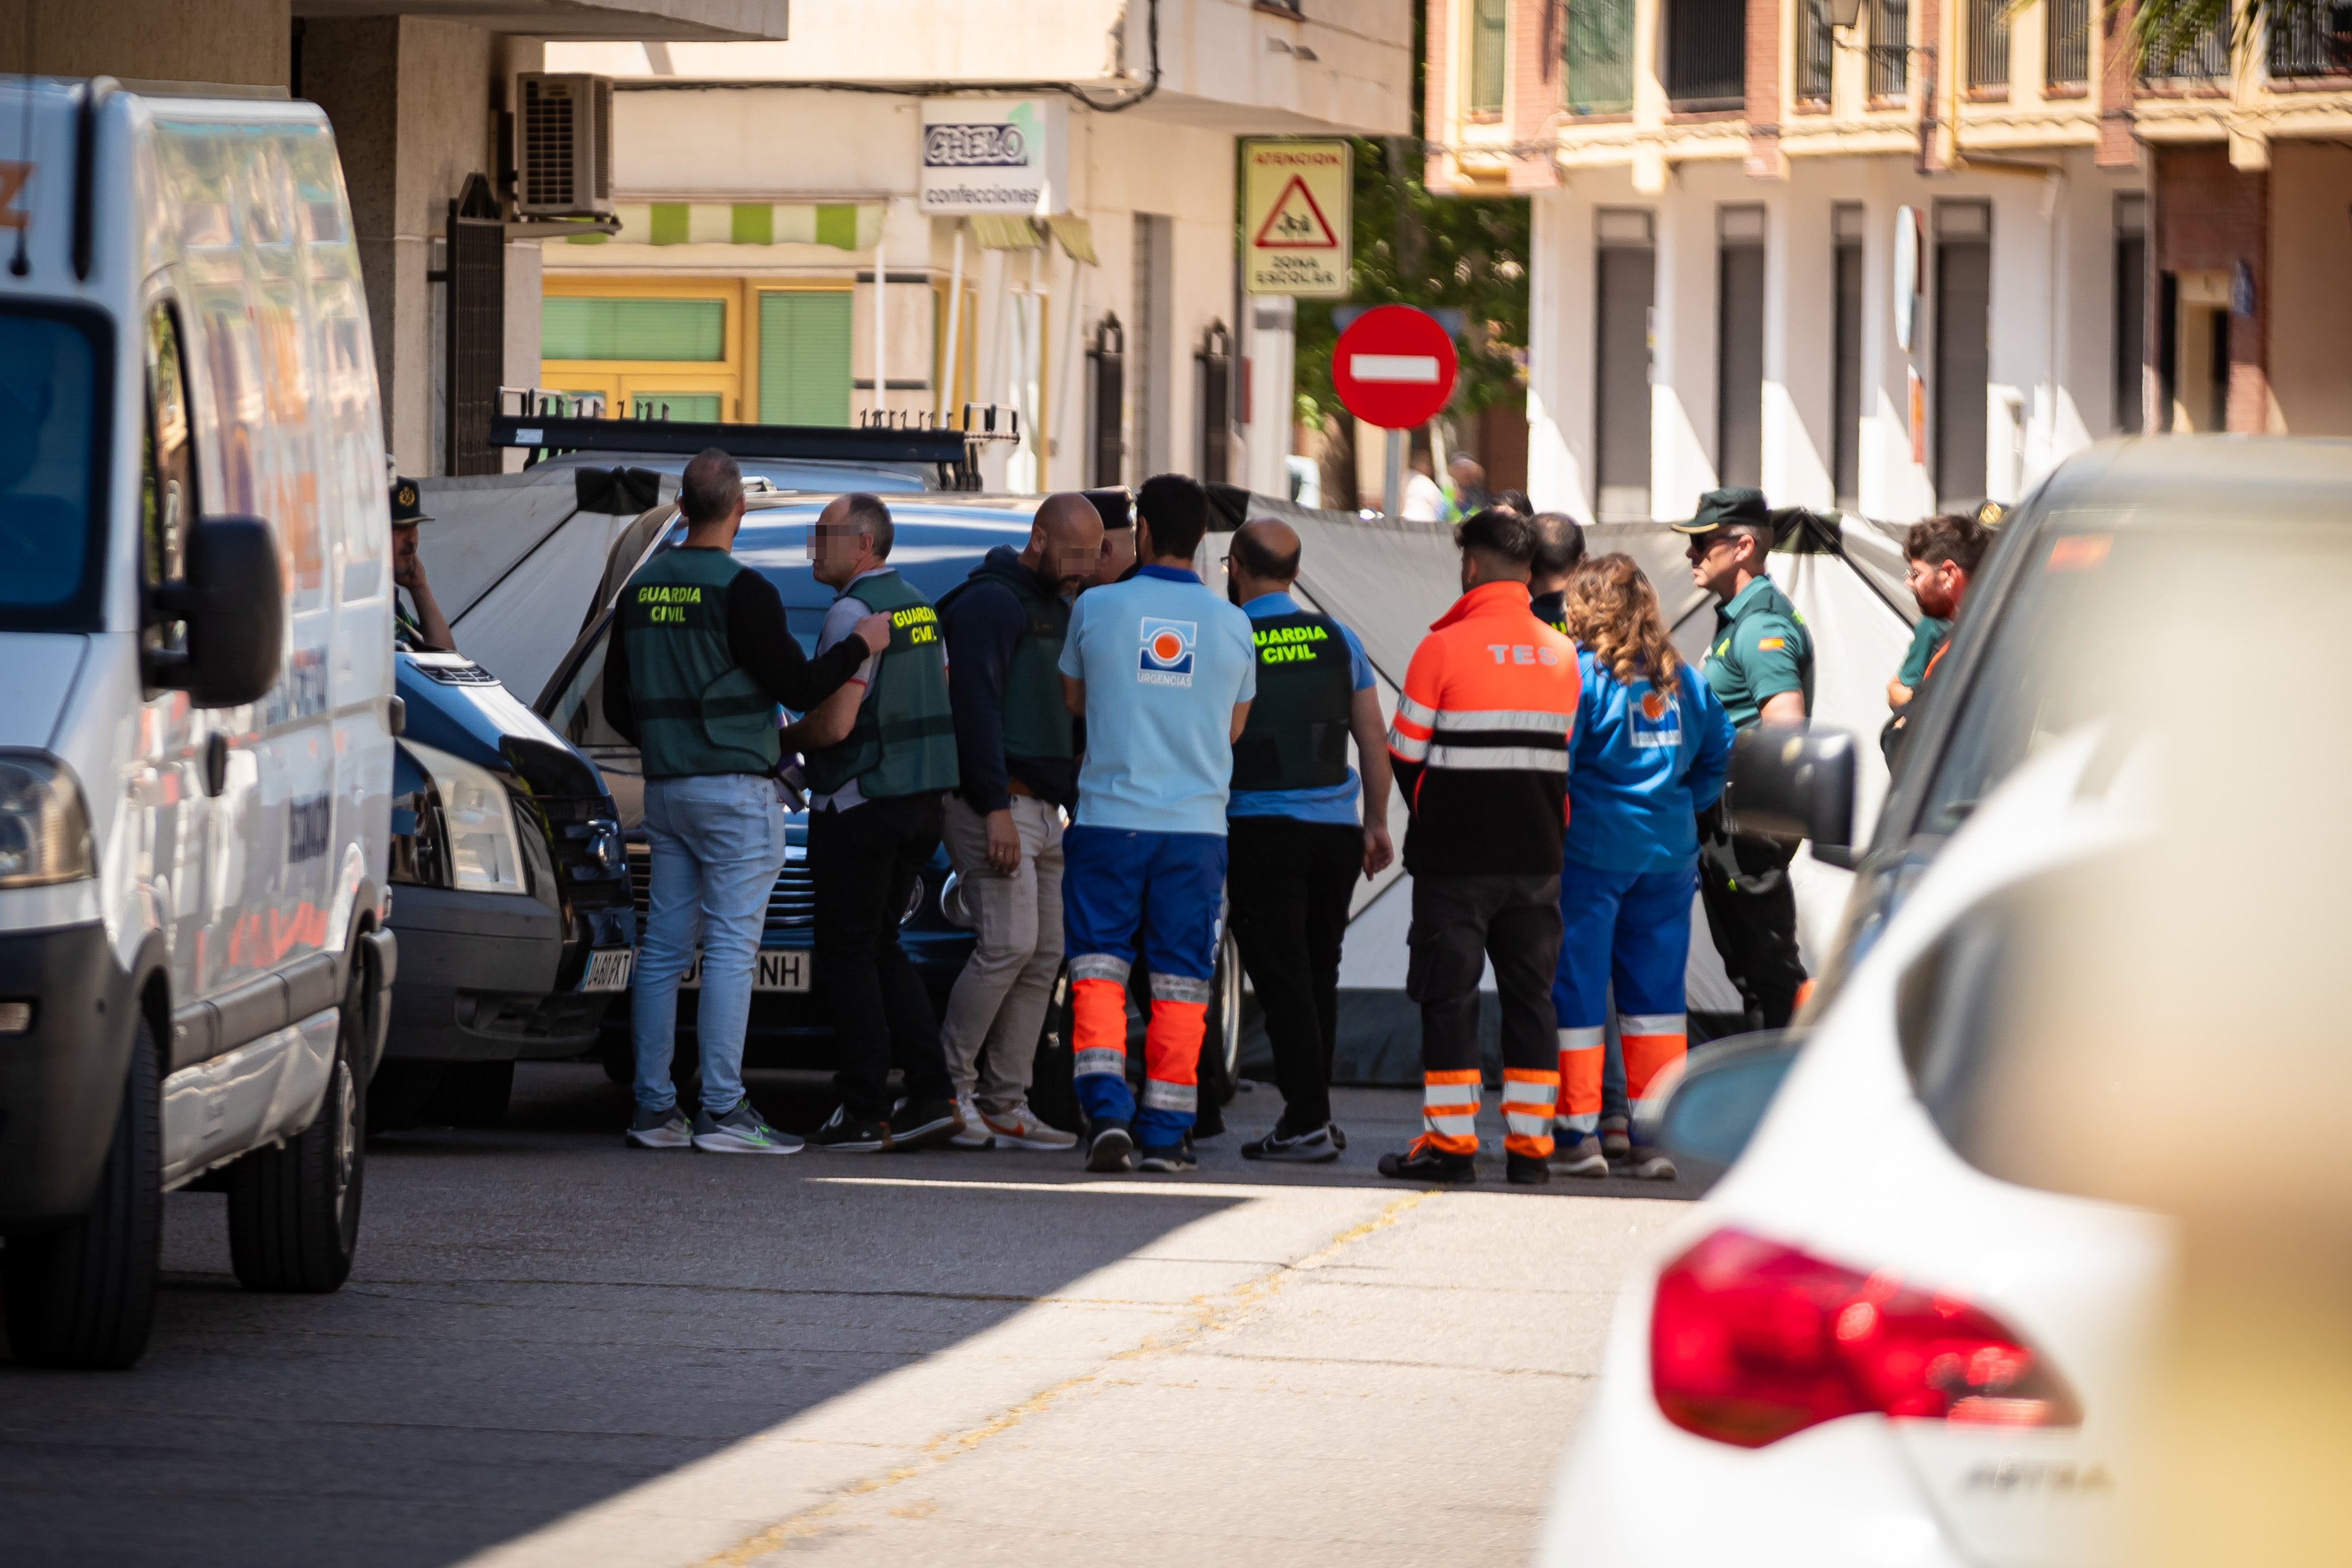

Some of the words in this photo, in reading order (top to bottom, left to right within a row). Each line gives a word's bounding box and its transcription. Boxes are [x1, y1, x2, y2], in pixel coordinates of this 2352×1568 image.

[1272, 255, 1321, 269] ZONA
[1255, 270, 1336, 285] ESCOLAR
[639, 587, 701, 603] GUARDIA
[650, 606, 686, 623] CIVIL
[1253, 626, 1328, 647] UARDIA
[1261, 644, 1317, 664] CIVIL
[1487, 644, 1558, 666] TES
[1137, 673, 1192, 688] URGENCIAS
[759, 955, 800, 987] NH
